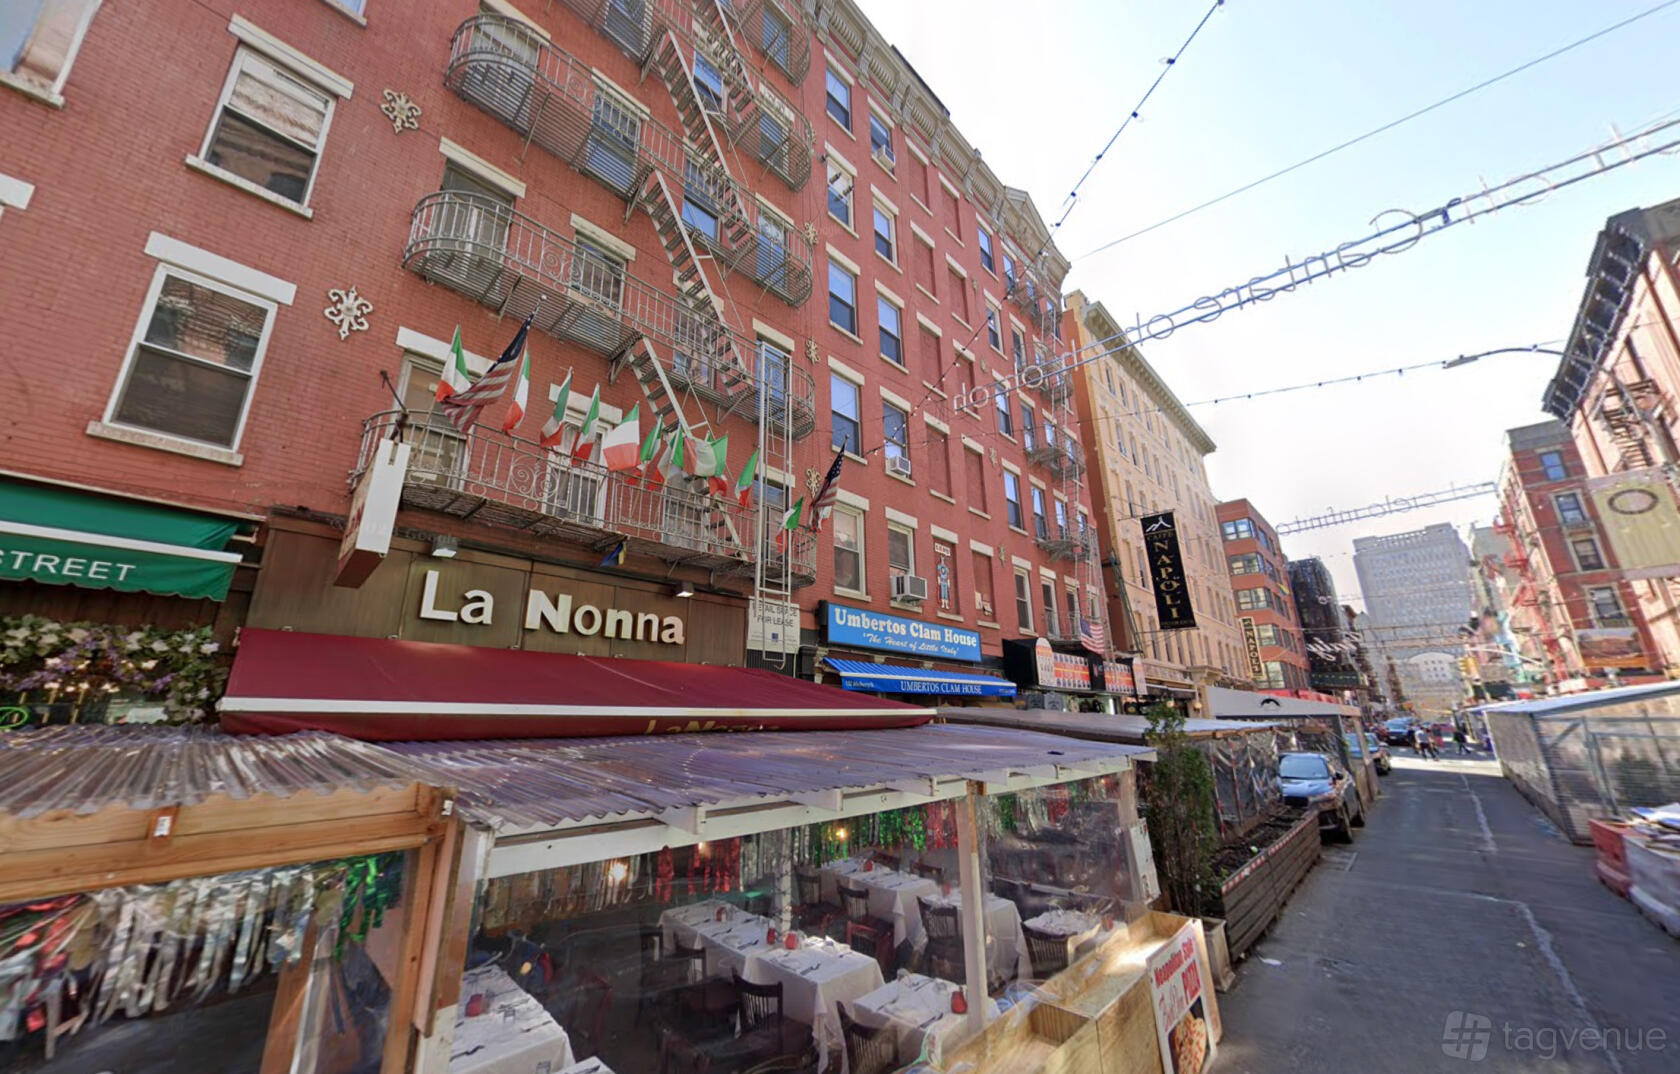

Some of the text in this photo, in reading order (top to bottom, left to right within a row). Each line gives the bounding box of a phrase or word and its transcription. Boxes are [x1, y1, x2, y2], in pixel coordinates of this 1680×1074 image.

[0, 549, 136, 581] TREET
[1153, 540, 1180, 618] NAPOLI
[419, 570, 685, 645] La Nonna
[834, 608, 977, 647] Umbertos Clam House
[900, 680, 982, 694] UMBERTOS CLAM HOUSE
